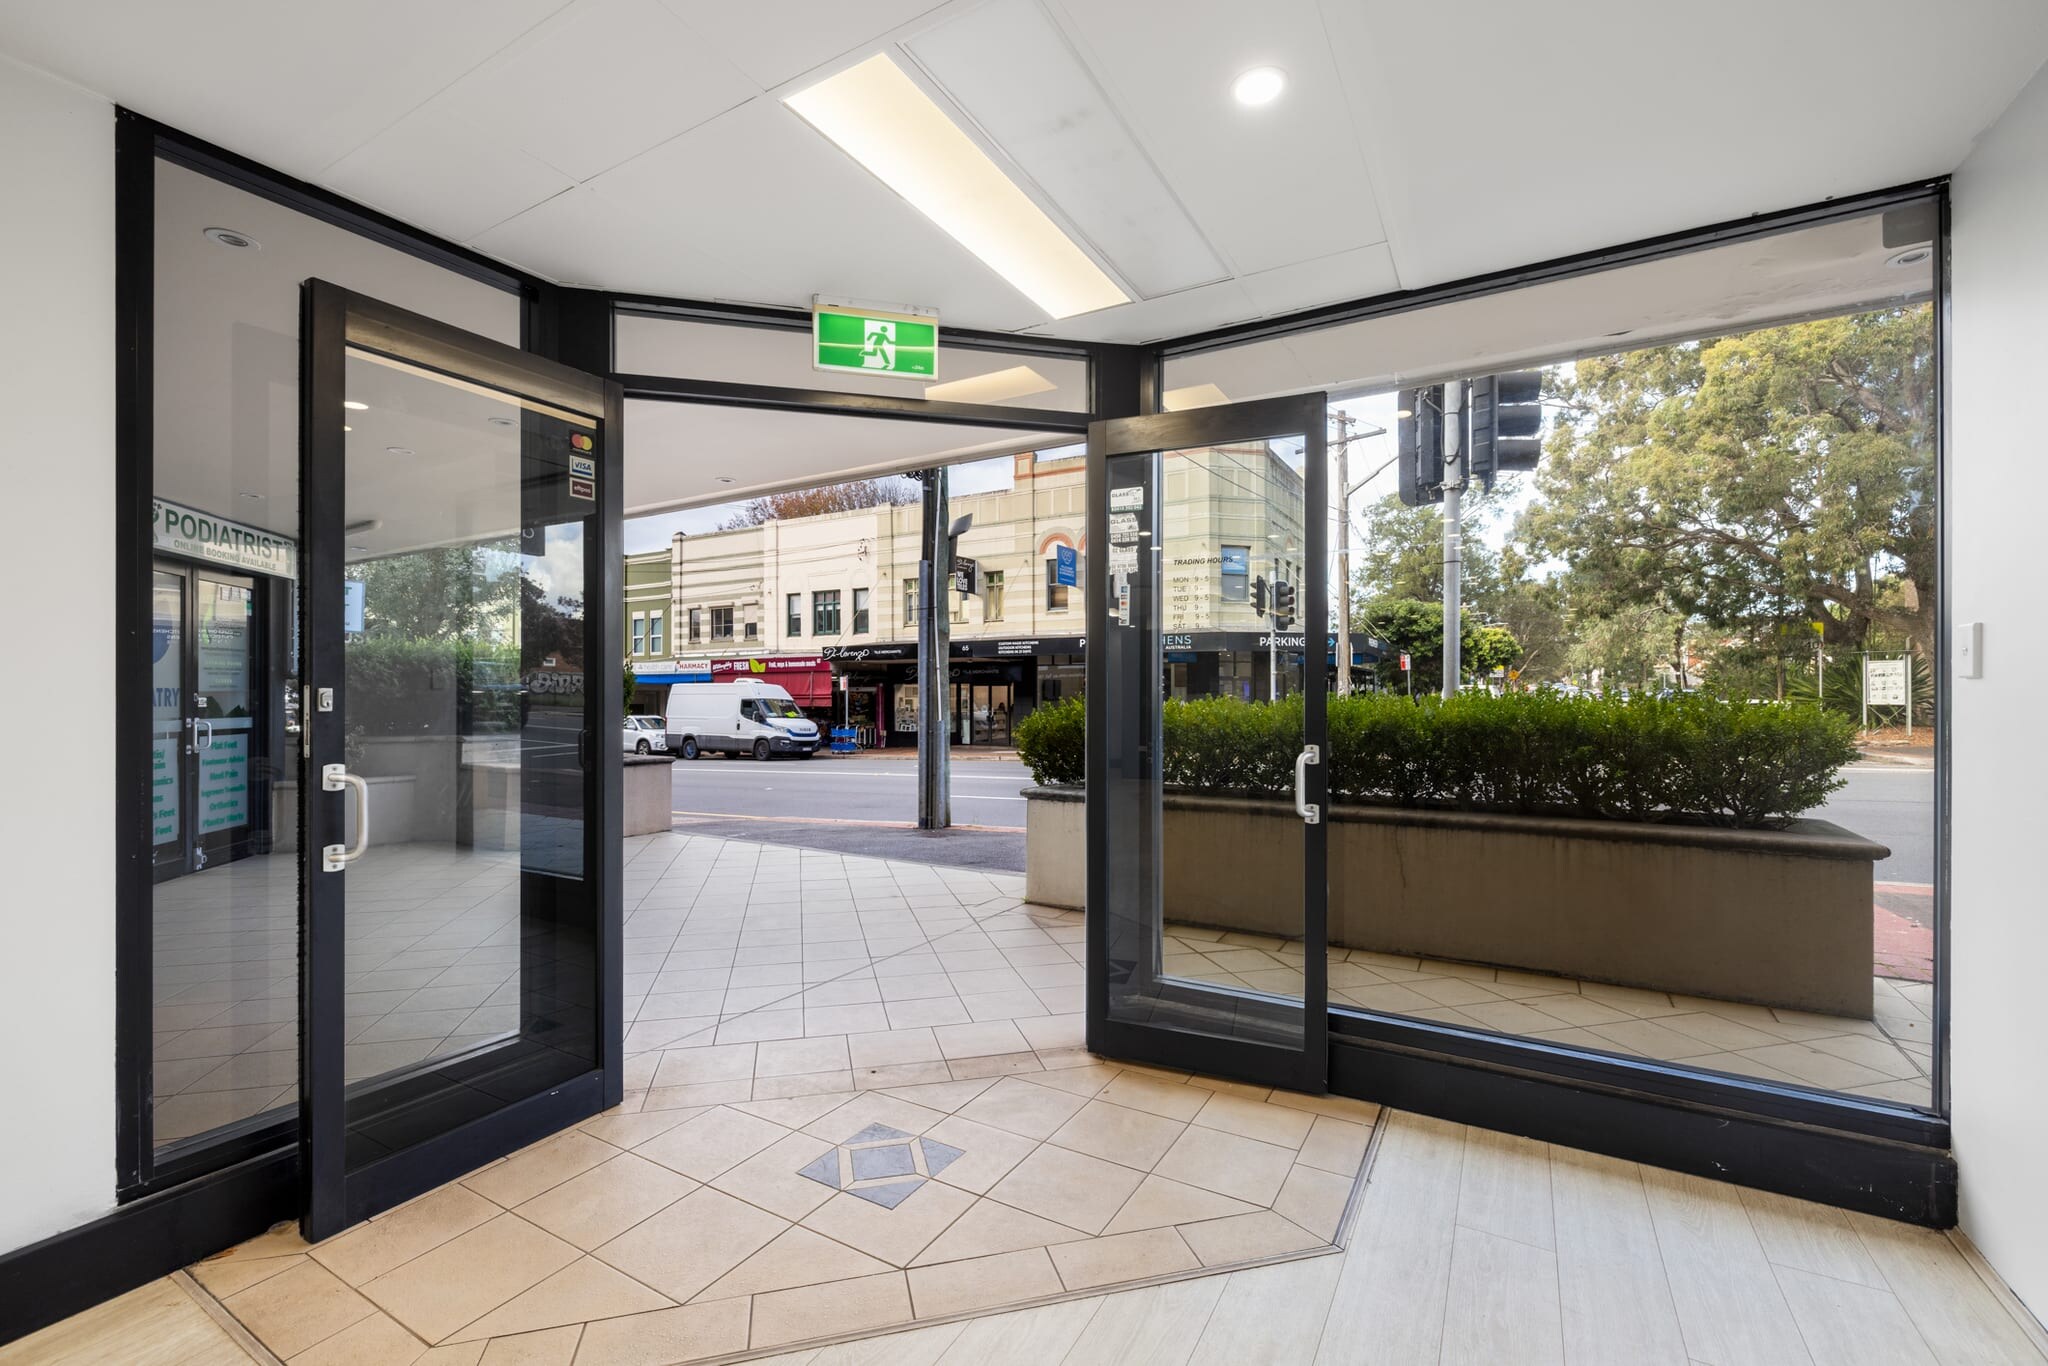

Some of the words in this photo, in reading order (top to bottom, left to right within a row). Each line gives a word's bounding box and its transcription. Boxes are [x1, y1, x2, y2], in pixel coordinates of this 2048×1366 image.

[574, 461, 592, 471] VISA
[165, 508, 282, 561] PODIATRIST
[206, 546, 242, 561] BOOKING
[241, 555, 277, 571] AVAILABLE
[1173, 558, 1206, 567] TRADING
[1207, 555, 1234, 564] HOURS
[1259, 637, 1305, 647] PARKING
[961, 644, 970, 652] 65
